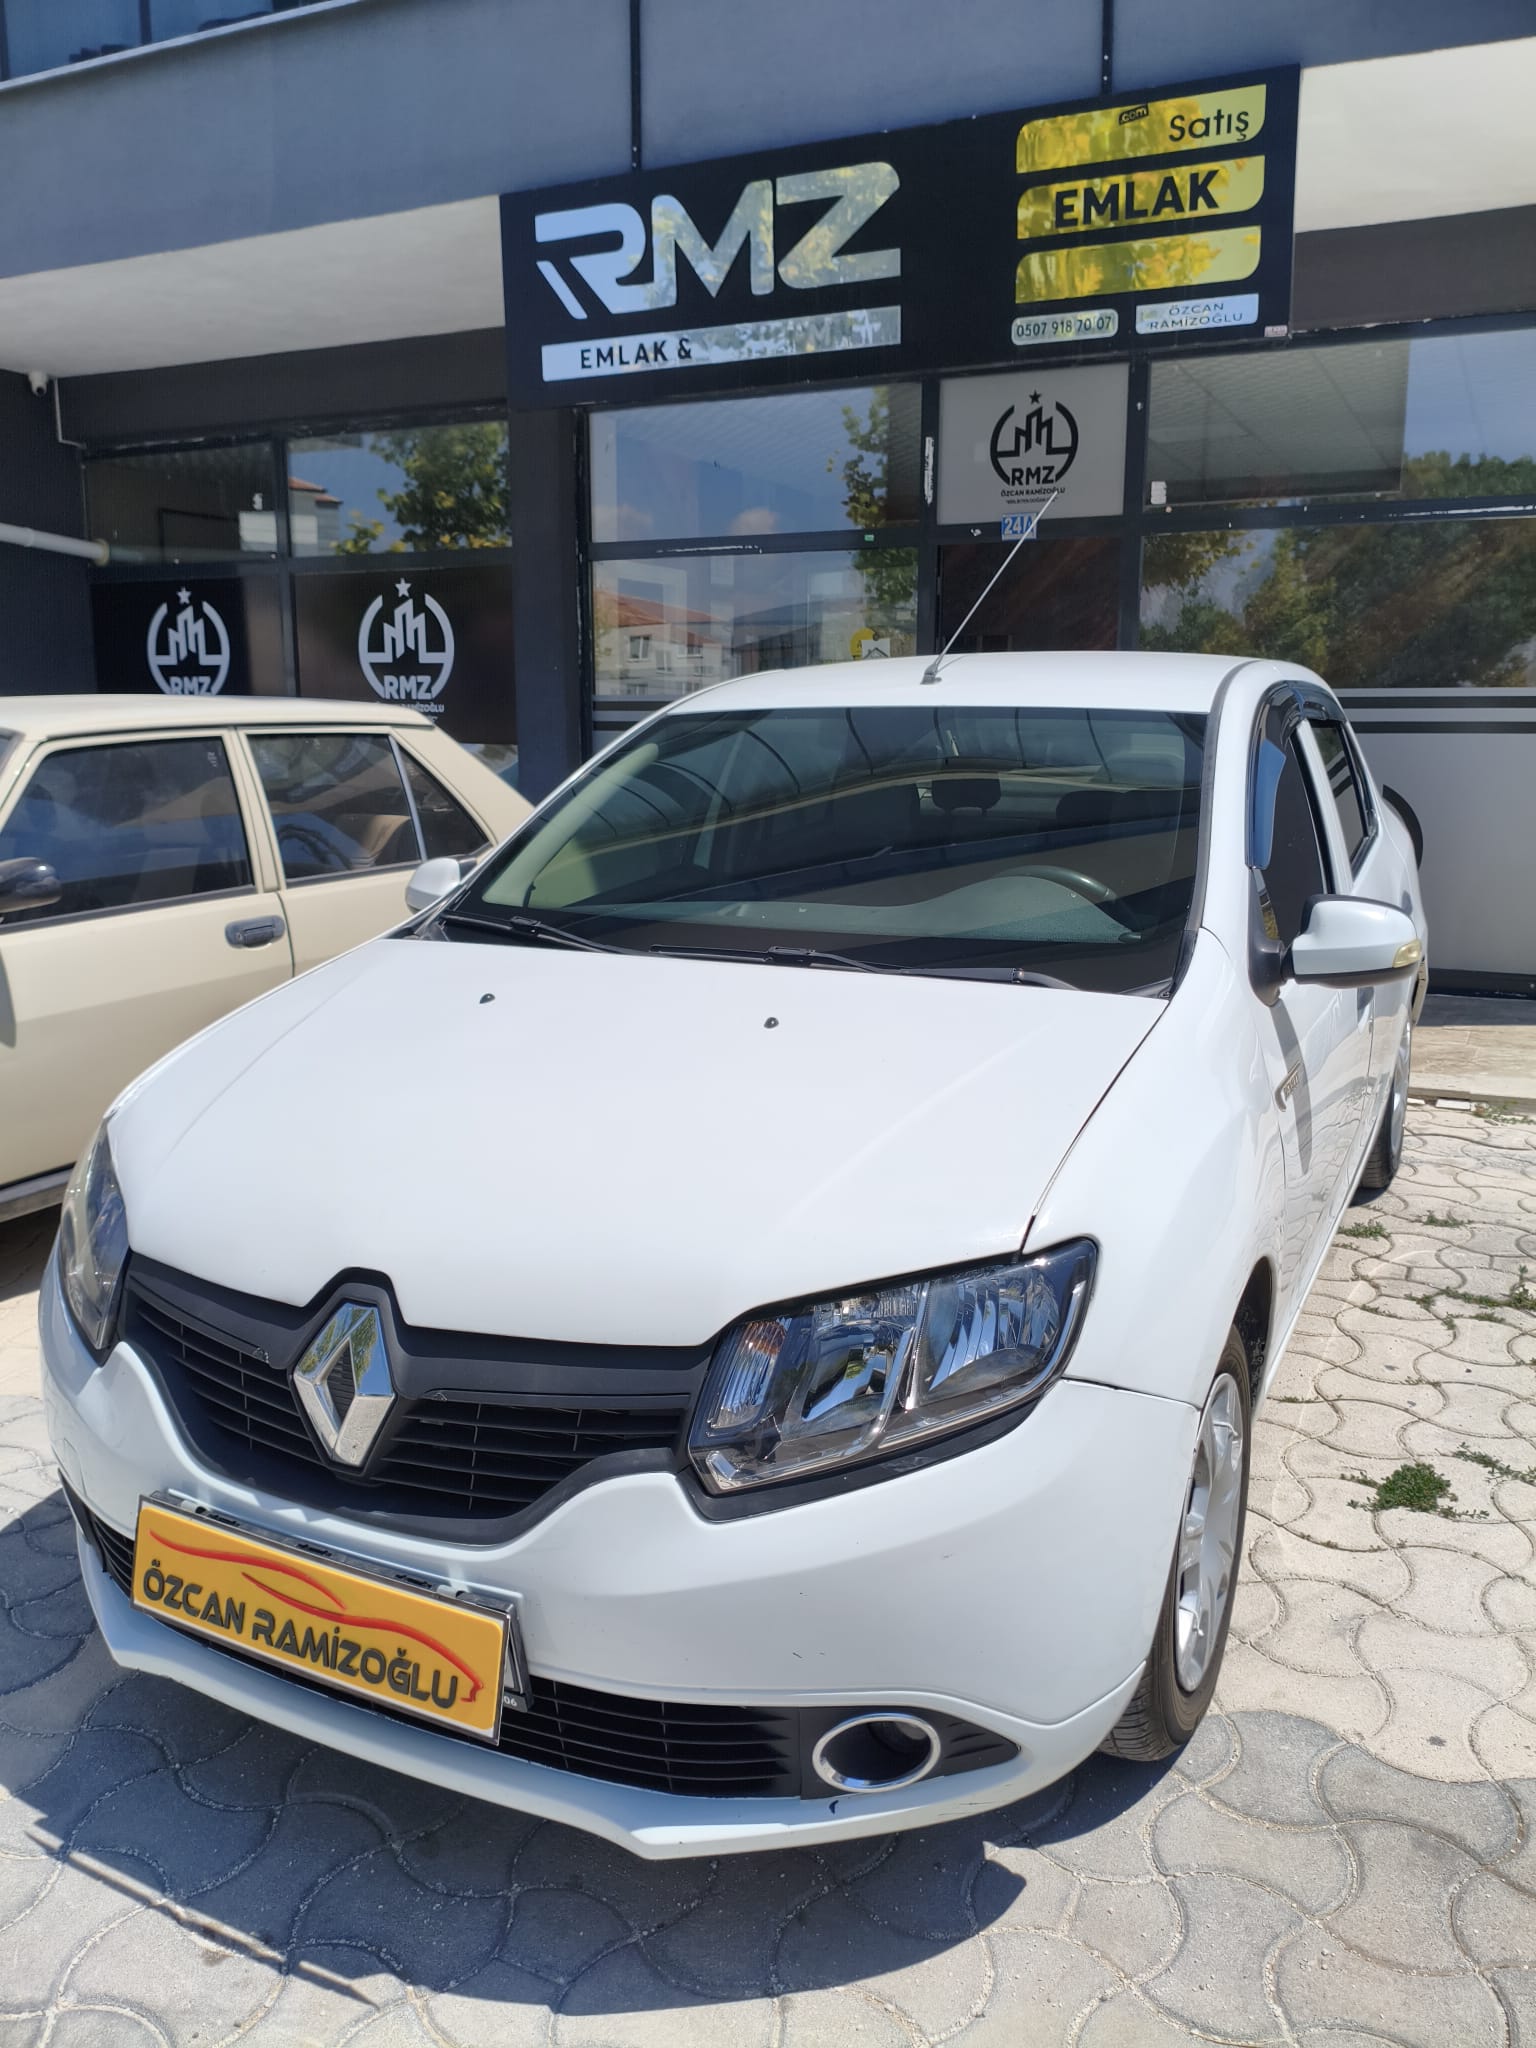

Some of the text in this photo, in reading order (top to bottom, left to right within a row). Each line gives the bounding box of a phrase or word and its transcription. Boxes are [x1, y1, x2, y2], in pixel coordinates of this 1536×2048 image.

[1168, 108, 1250, 142] Satış
[1054, 169, 1221, 229] EMLAK
[534, 161, 901, 320] RMZ
[1168, 301, 1225, 317] ÖZCAN
[1016, 315, 1112, 338] 0507 918 70 07
[580, 337, 693, 370] EMLAK &
[1011, 466, 1055, 487] RMZ
[169, 675, 211, 695] RMZ
[384, 675, 432, 700] RMZ
[141, 1559, 459, 1710] ÖZCAN RAMİZOĞLU
